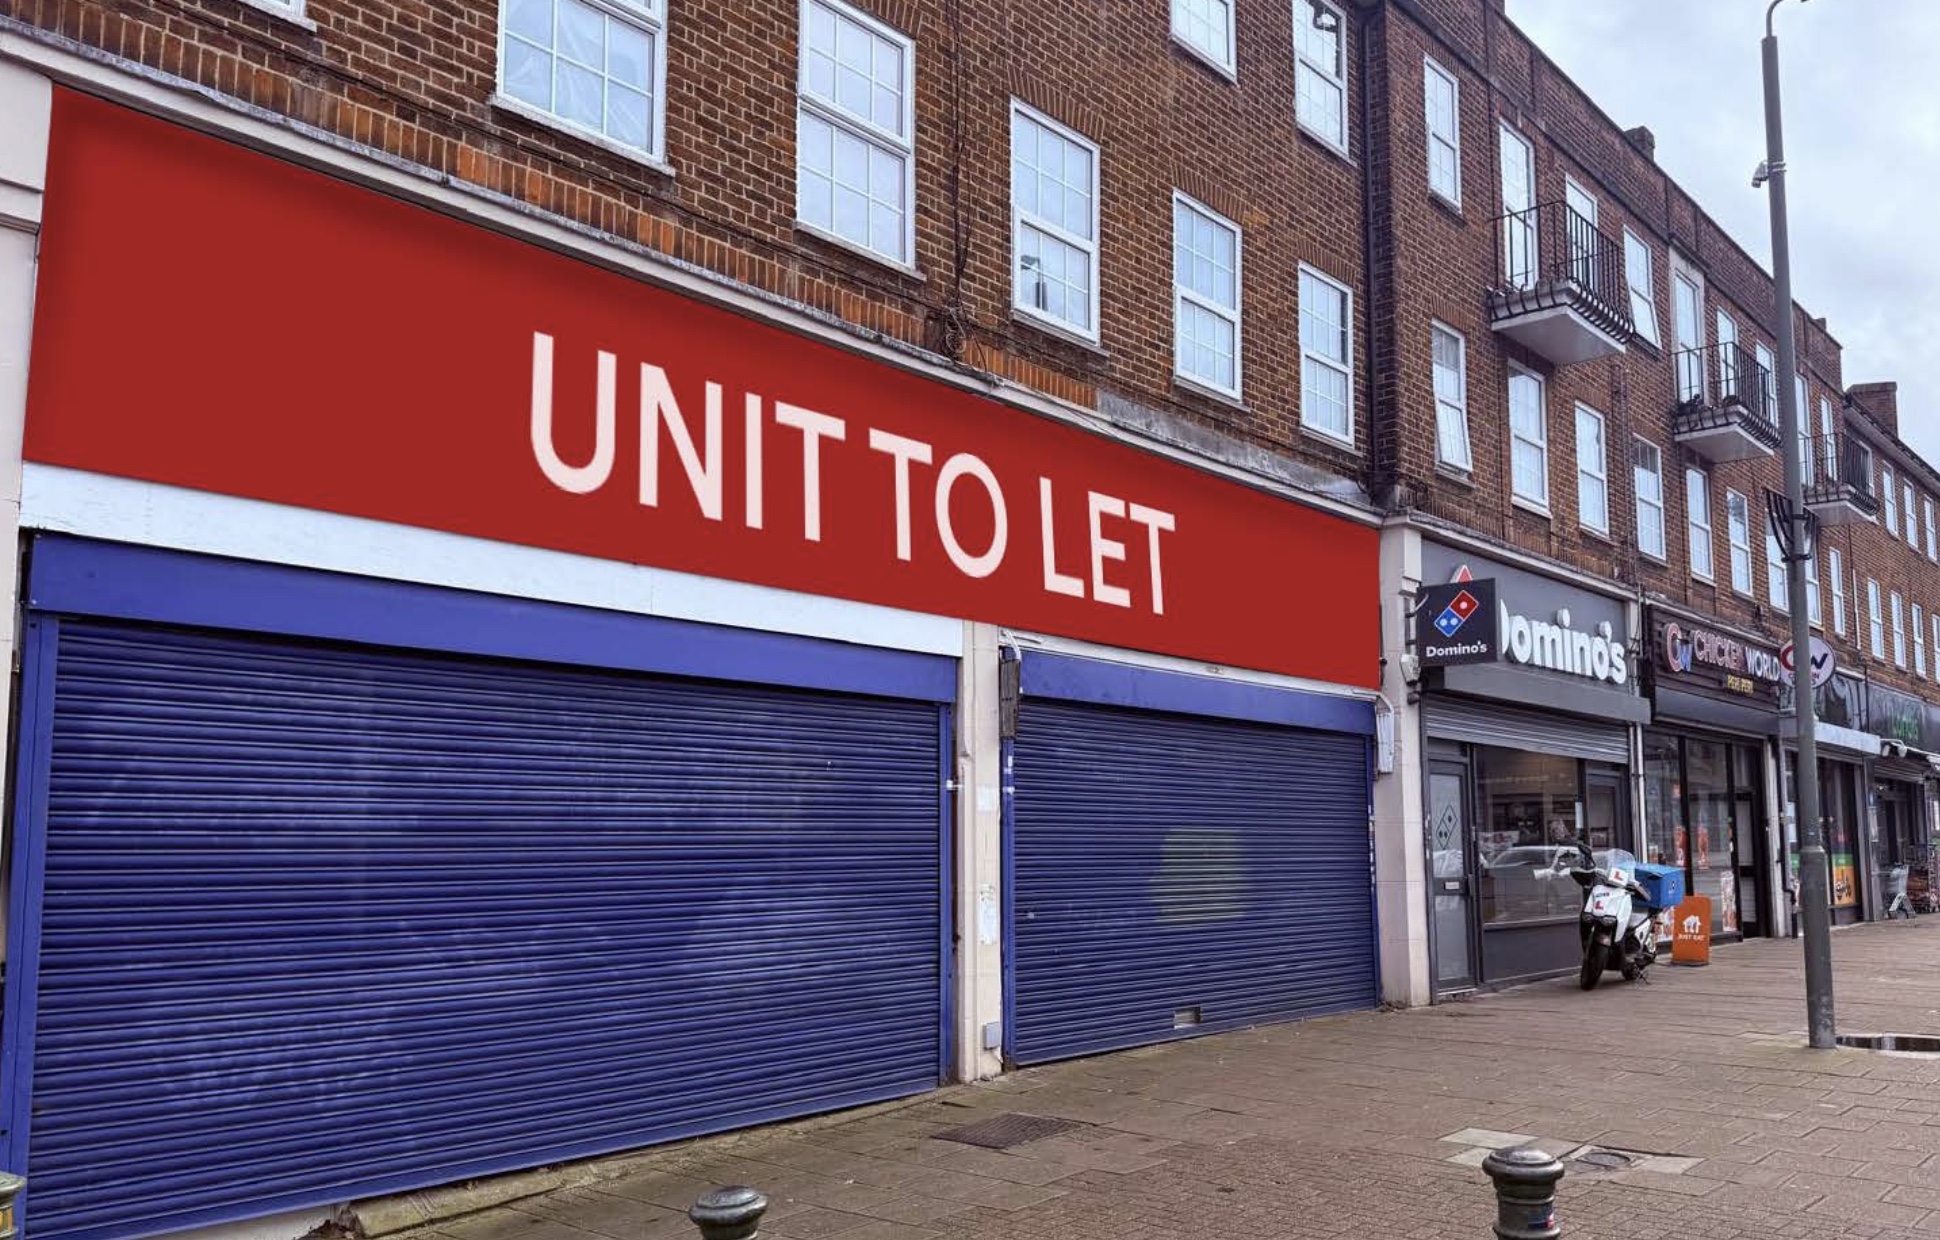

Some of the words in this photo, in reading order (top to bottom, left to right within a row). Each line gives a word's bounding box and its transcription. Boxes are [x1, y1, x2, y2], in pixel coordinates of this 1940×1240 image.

[531, 331, 845, 542] UNIT
[869, 428, 1008, 578] TO
[1039, 476, 1175, 615] LET
[1426, 640, 1487, 658] Domino's
[1694, 630, 1746, 671] CHICKEN
[1745, 646, 1780, 681] WORLD
[1614, 871, 1624, 881] L
[1595, 900, 1604, 910] L
